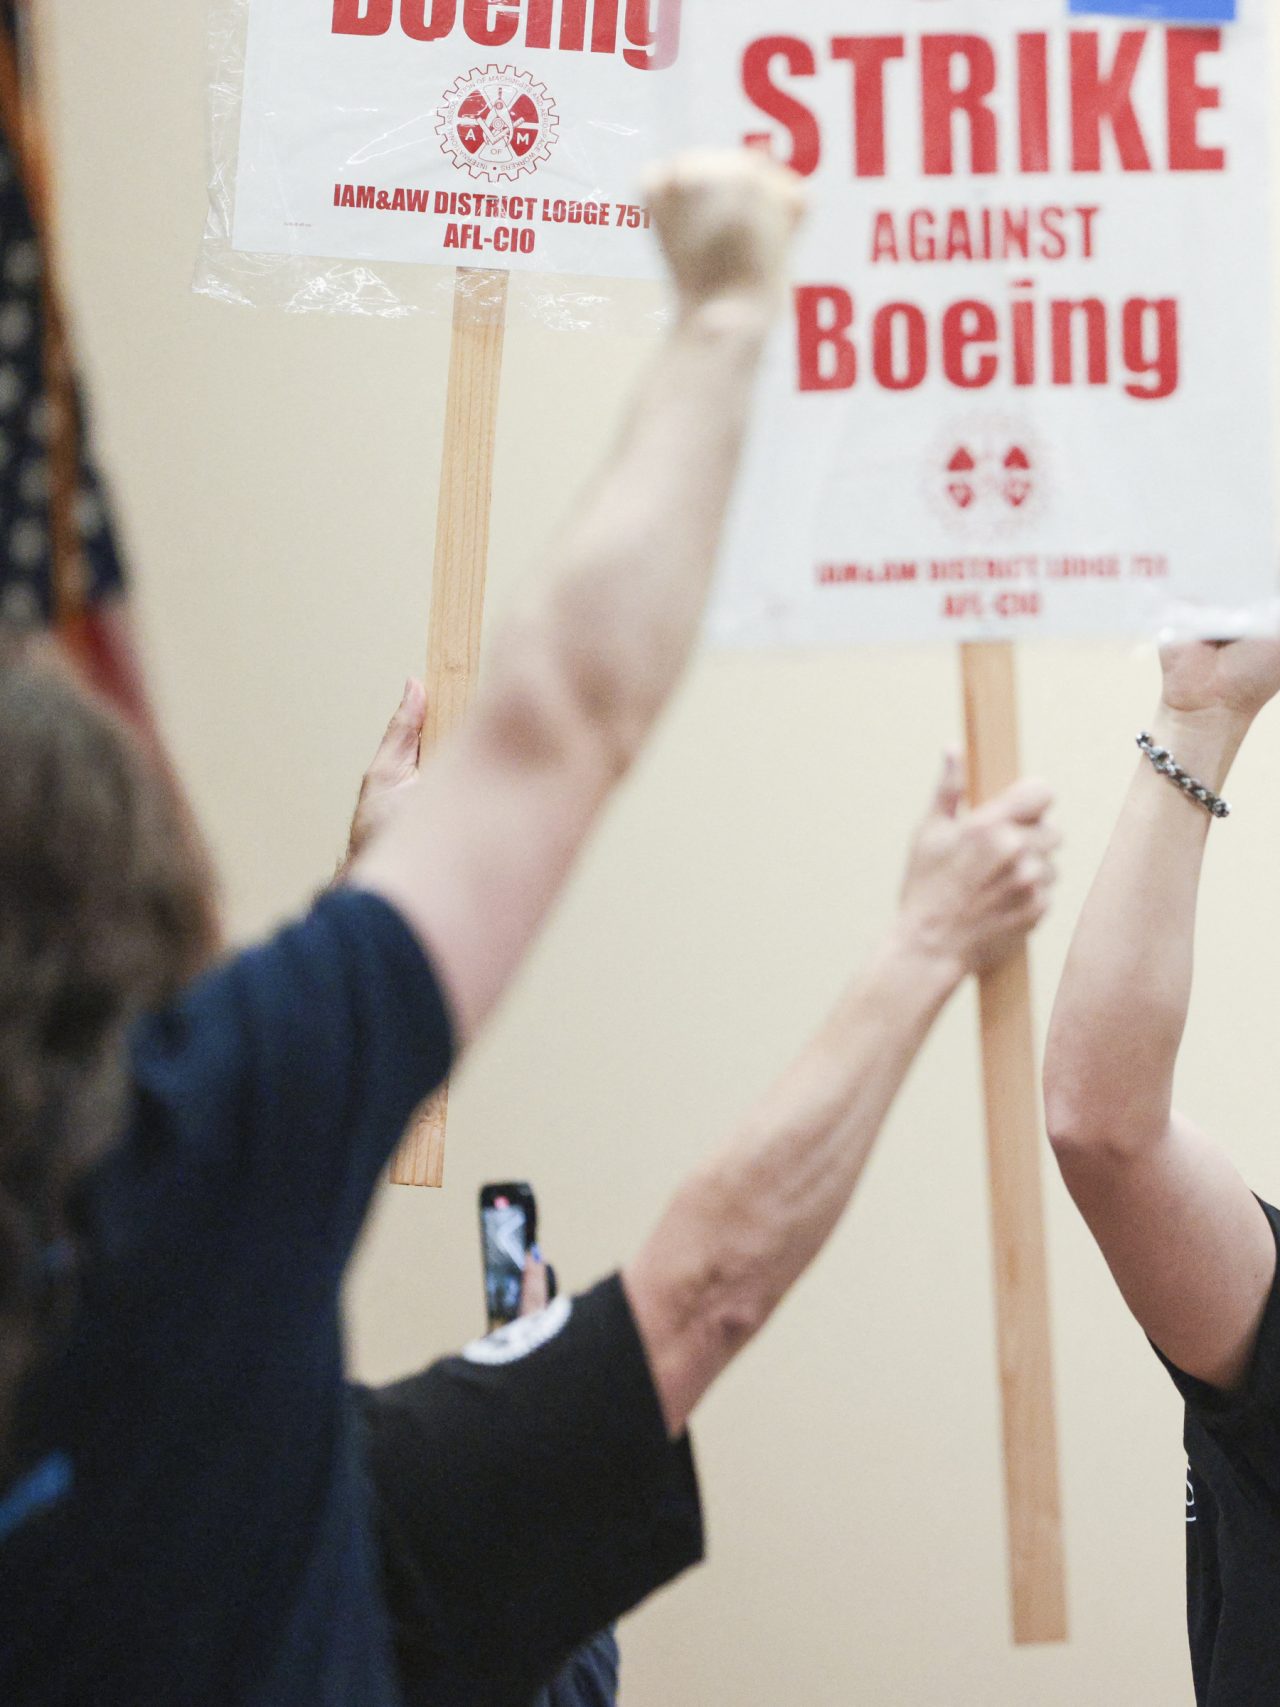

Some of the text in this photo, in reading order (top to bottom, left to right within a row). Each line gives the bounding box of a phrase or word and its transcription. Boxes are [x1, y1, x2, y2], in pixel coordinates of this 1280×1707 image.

[742, 28, 1226, 180] STRIKE
[464, 128, 529, 146] A M
[334, 184, 651, 229] IAM&AW DISTRICT LODGE 751
[443, 223, 536, 254] AFL-CIO
[871, 207, 1100, 264] AGAINST
[794, 278, 1181, 401] Boeing
